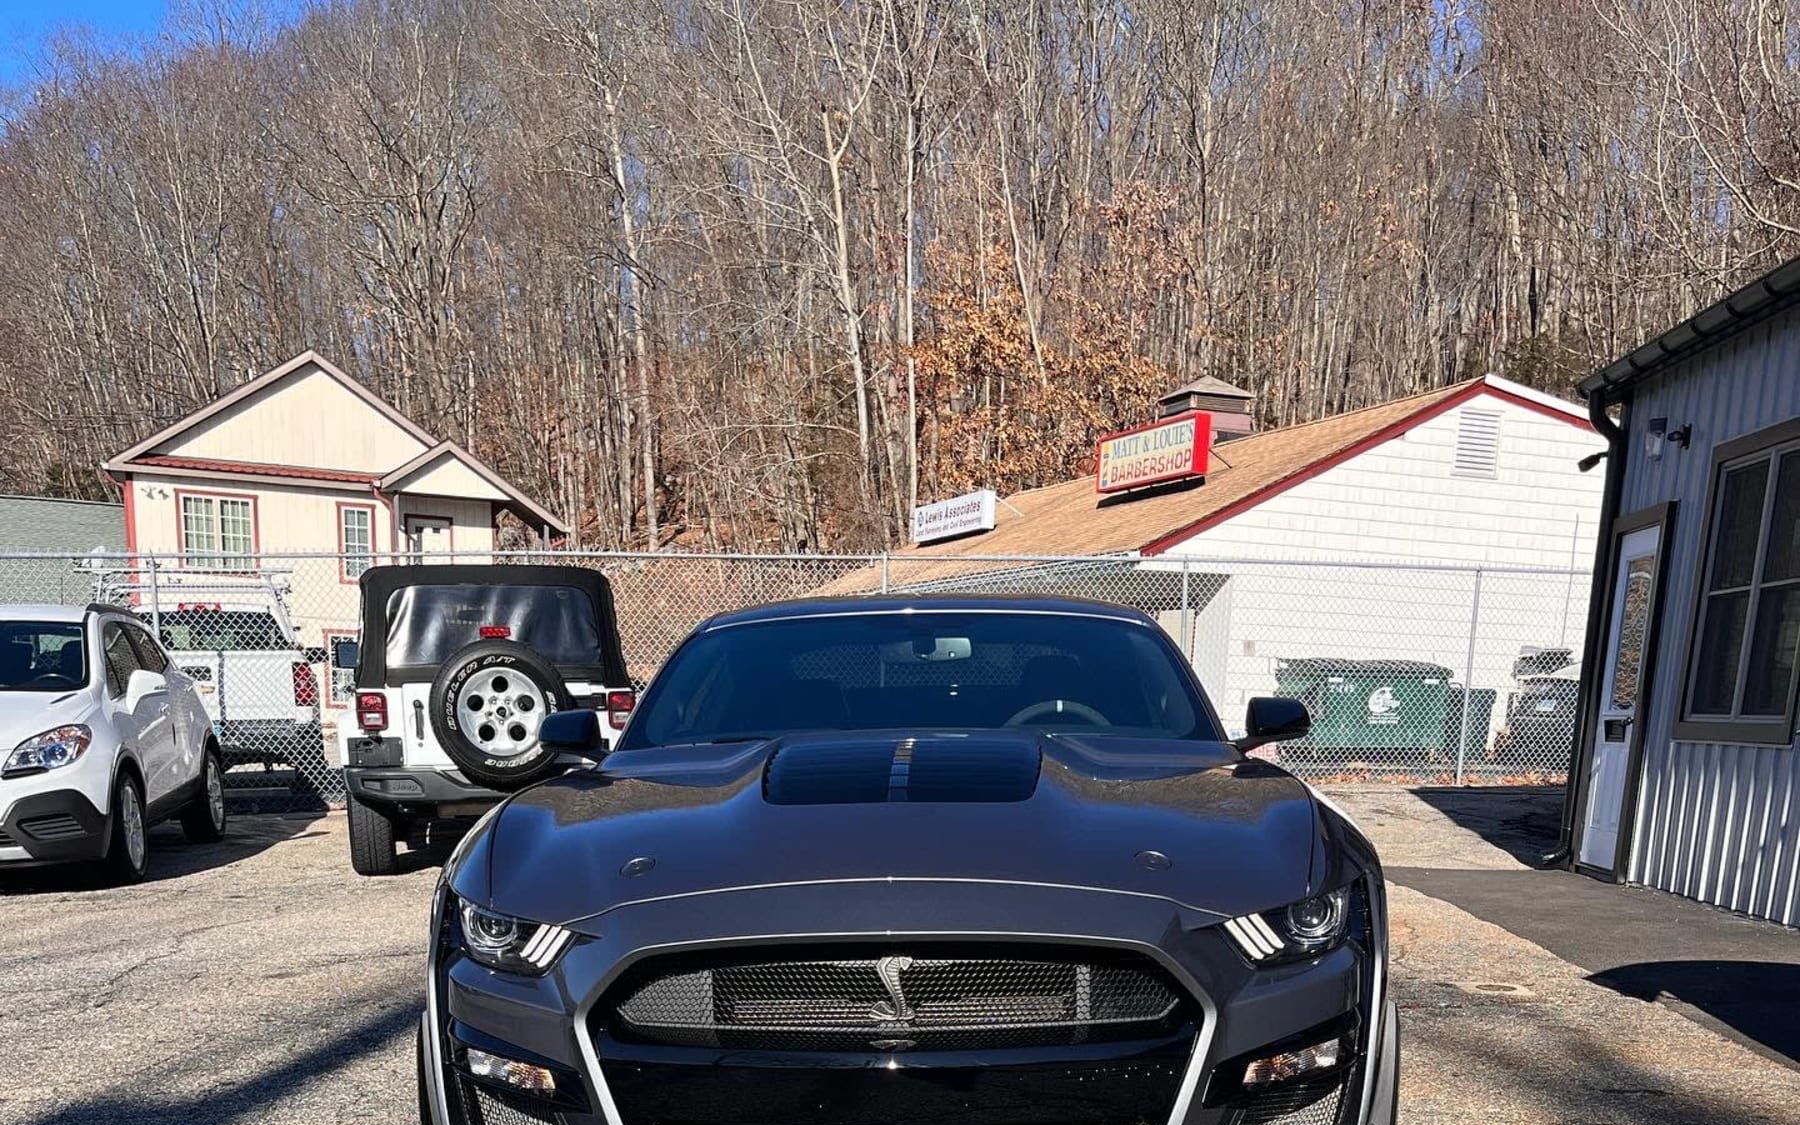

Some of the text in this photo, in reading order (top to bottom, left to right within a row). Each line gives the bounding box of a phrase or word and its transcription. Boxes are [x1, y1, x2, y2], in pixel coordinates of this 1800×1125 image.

[1112, 422, 1194, 460] MATT & LOUIE'S
[1111, 448, 1192, 483] BARBERSHOP
[925, 501, 981, 524] Lewis Associates
